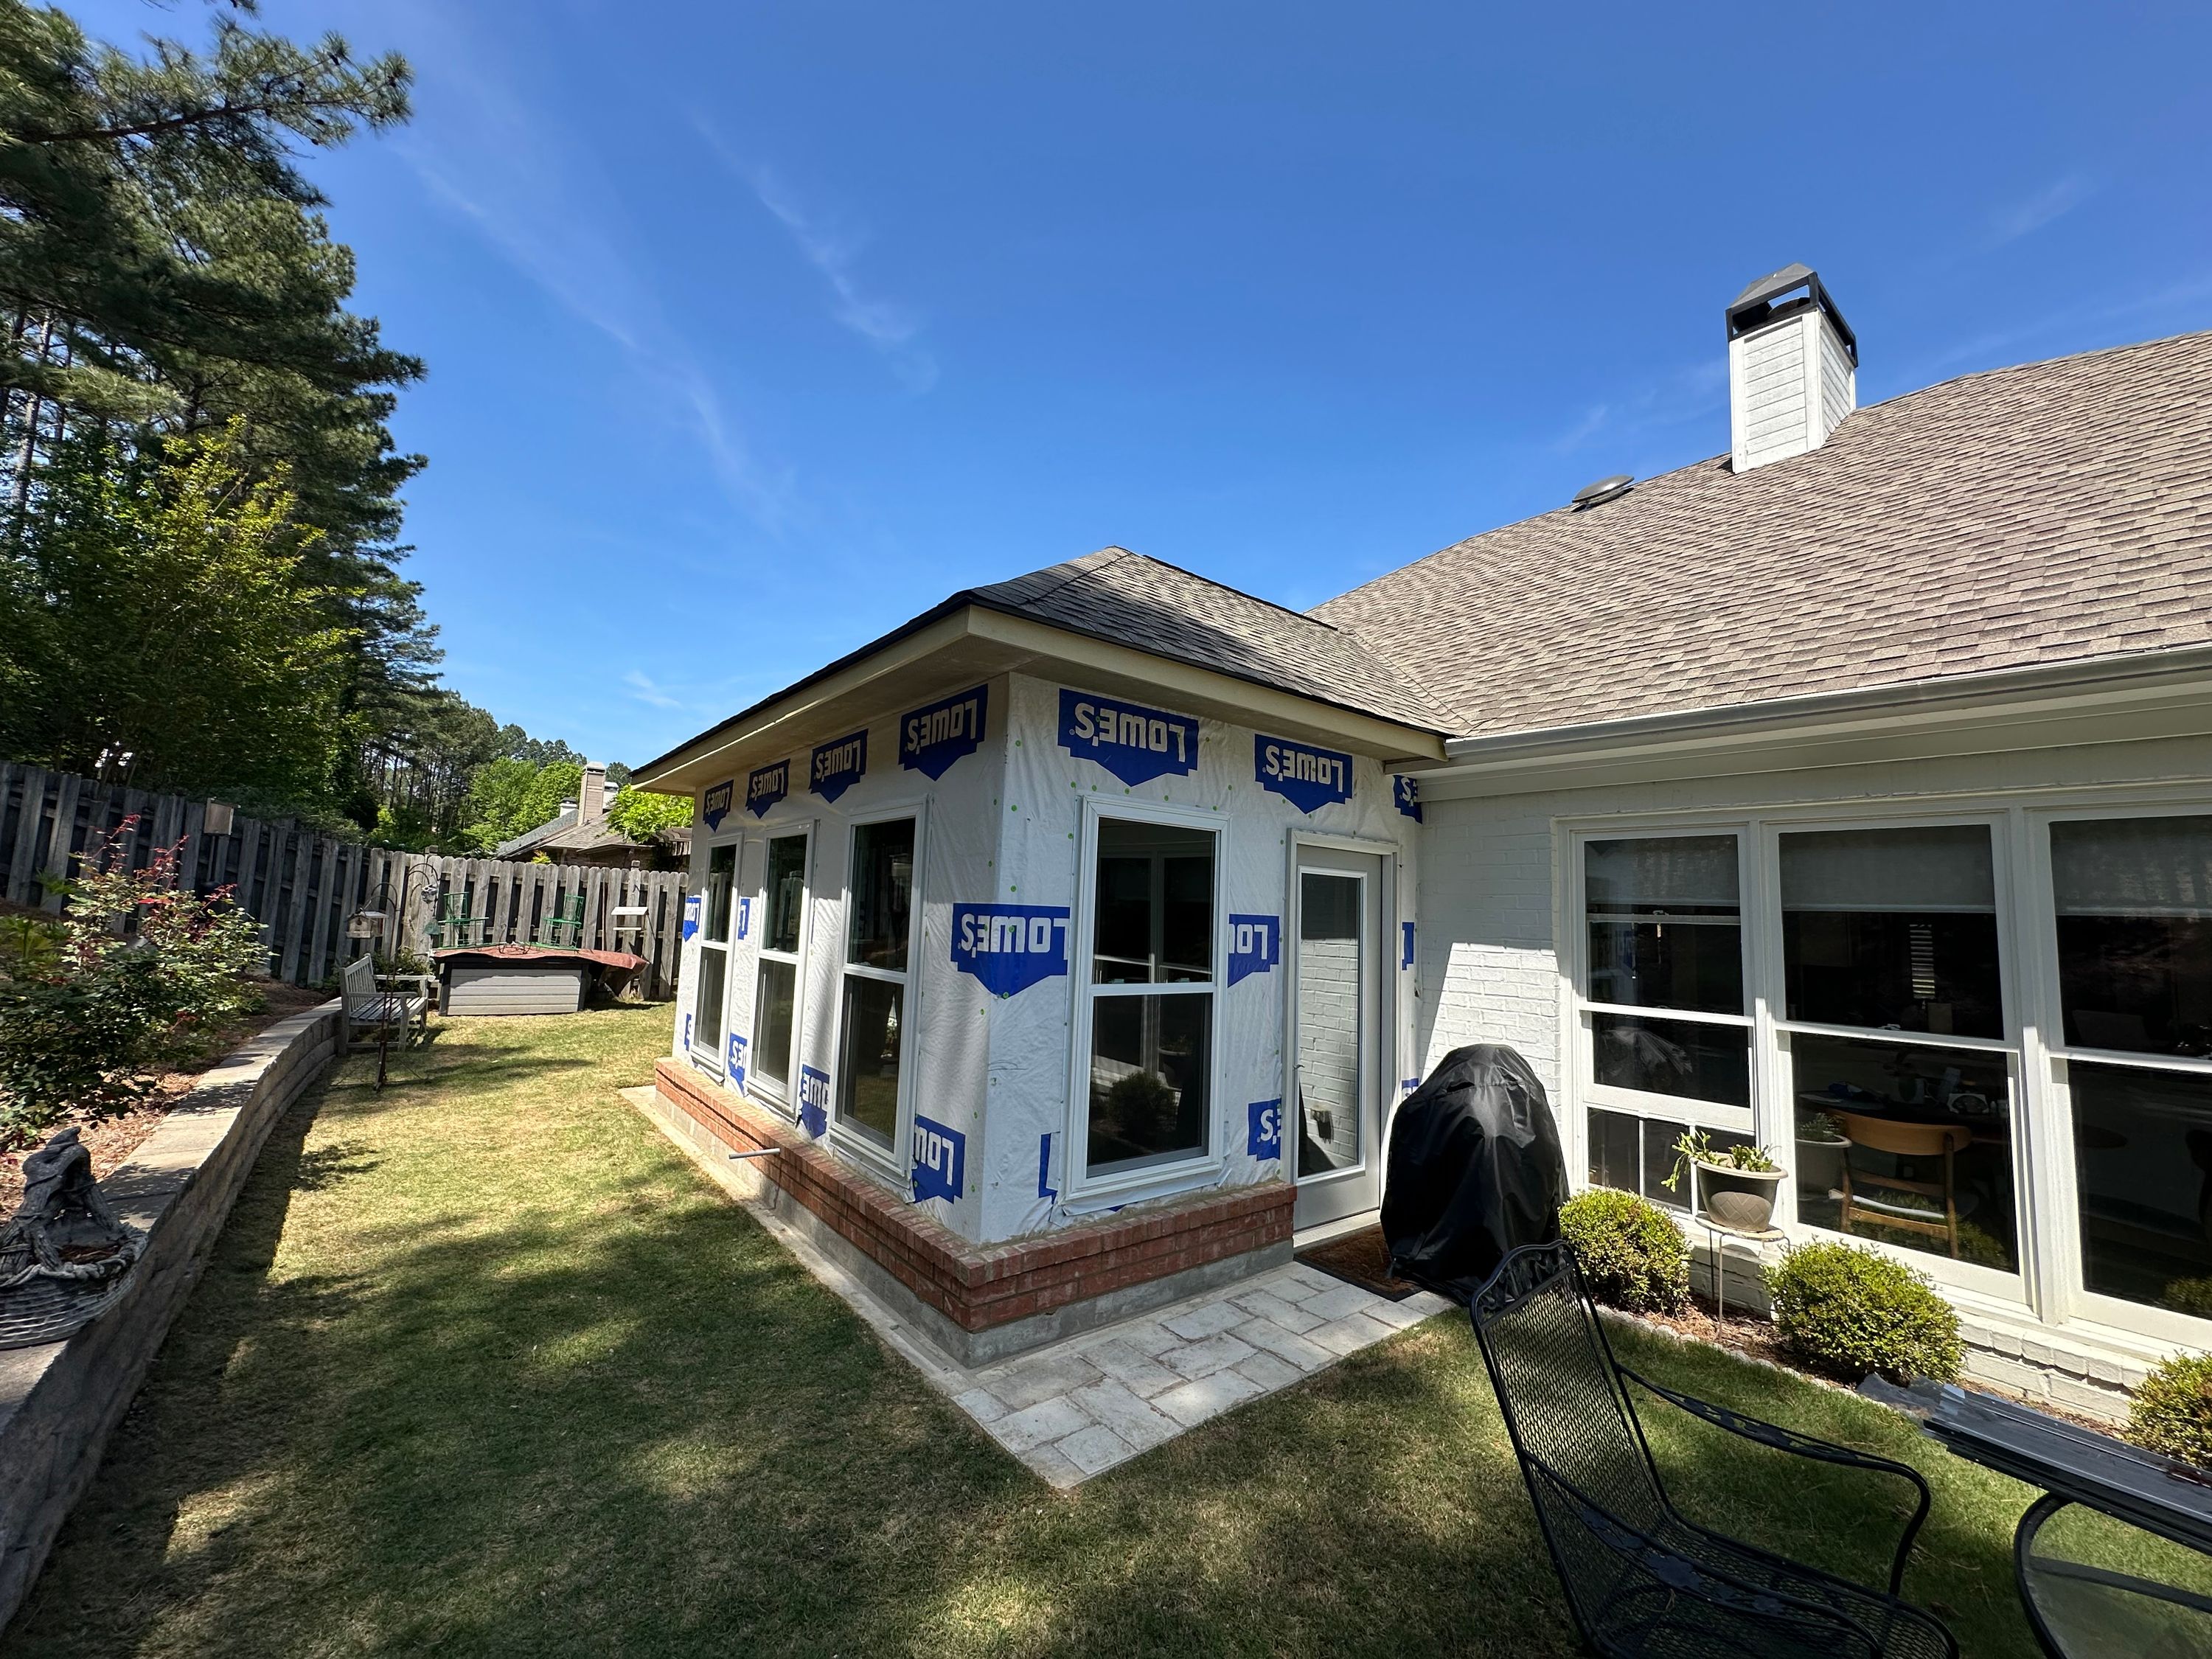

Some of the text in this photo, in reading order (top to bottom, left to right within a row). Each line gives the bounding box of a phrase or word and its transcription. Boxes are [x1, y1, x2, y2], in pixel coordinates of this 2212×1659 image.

[908, 698, 978, 754] LOWE'S
[1075, 703, 1186, 762] LOWE'S
[751, 768, 784, 801] LOWE'S
[815, 740, 860, 782] LOWE'S
[1265, 745, 1343, 793] LOWE'S
[706, 787, 730, 815] LOWE'S
[961, 913, 1069, 960] LOWE'S
